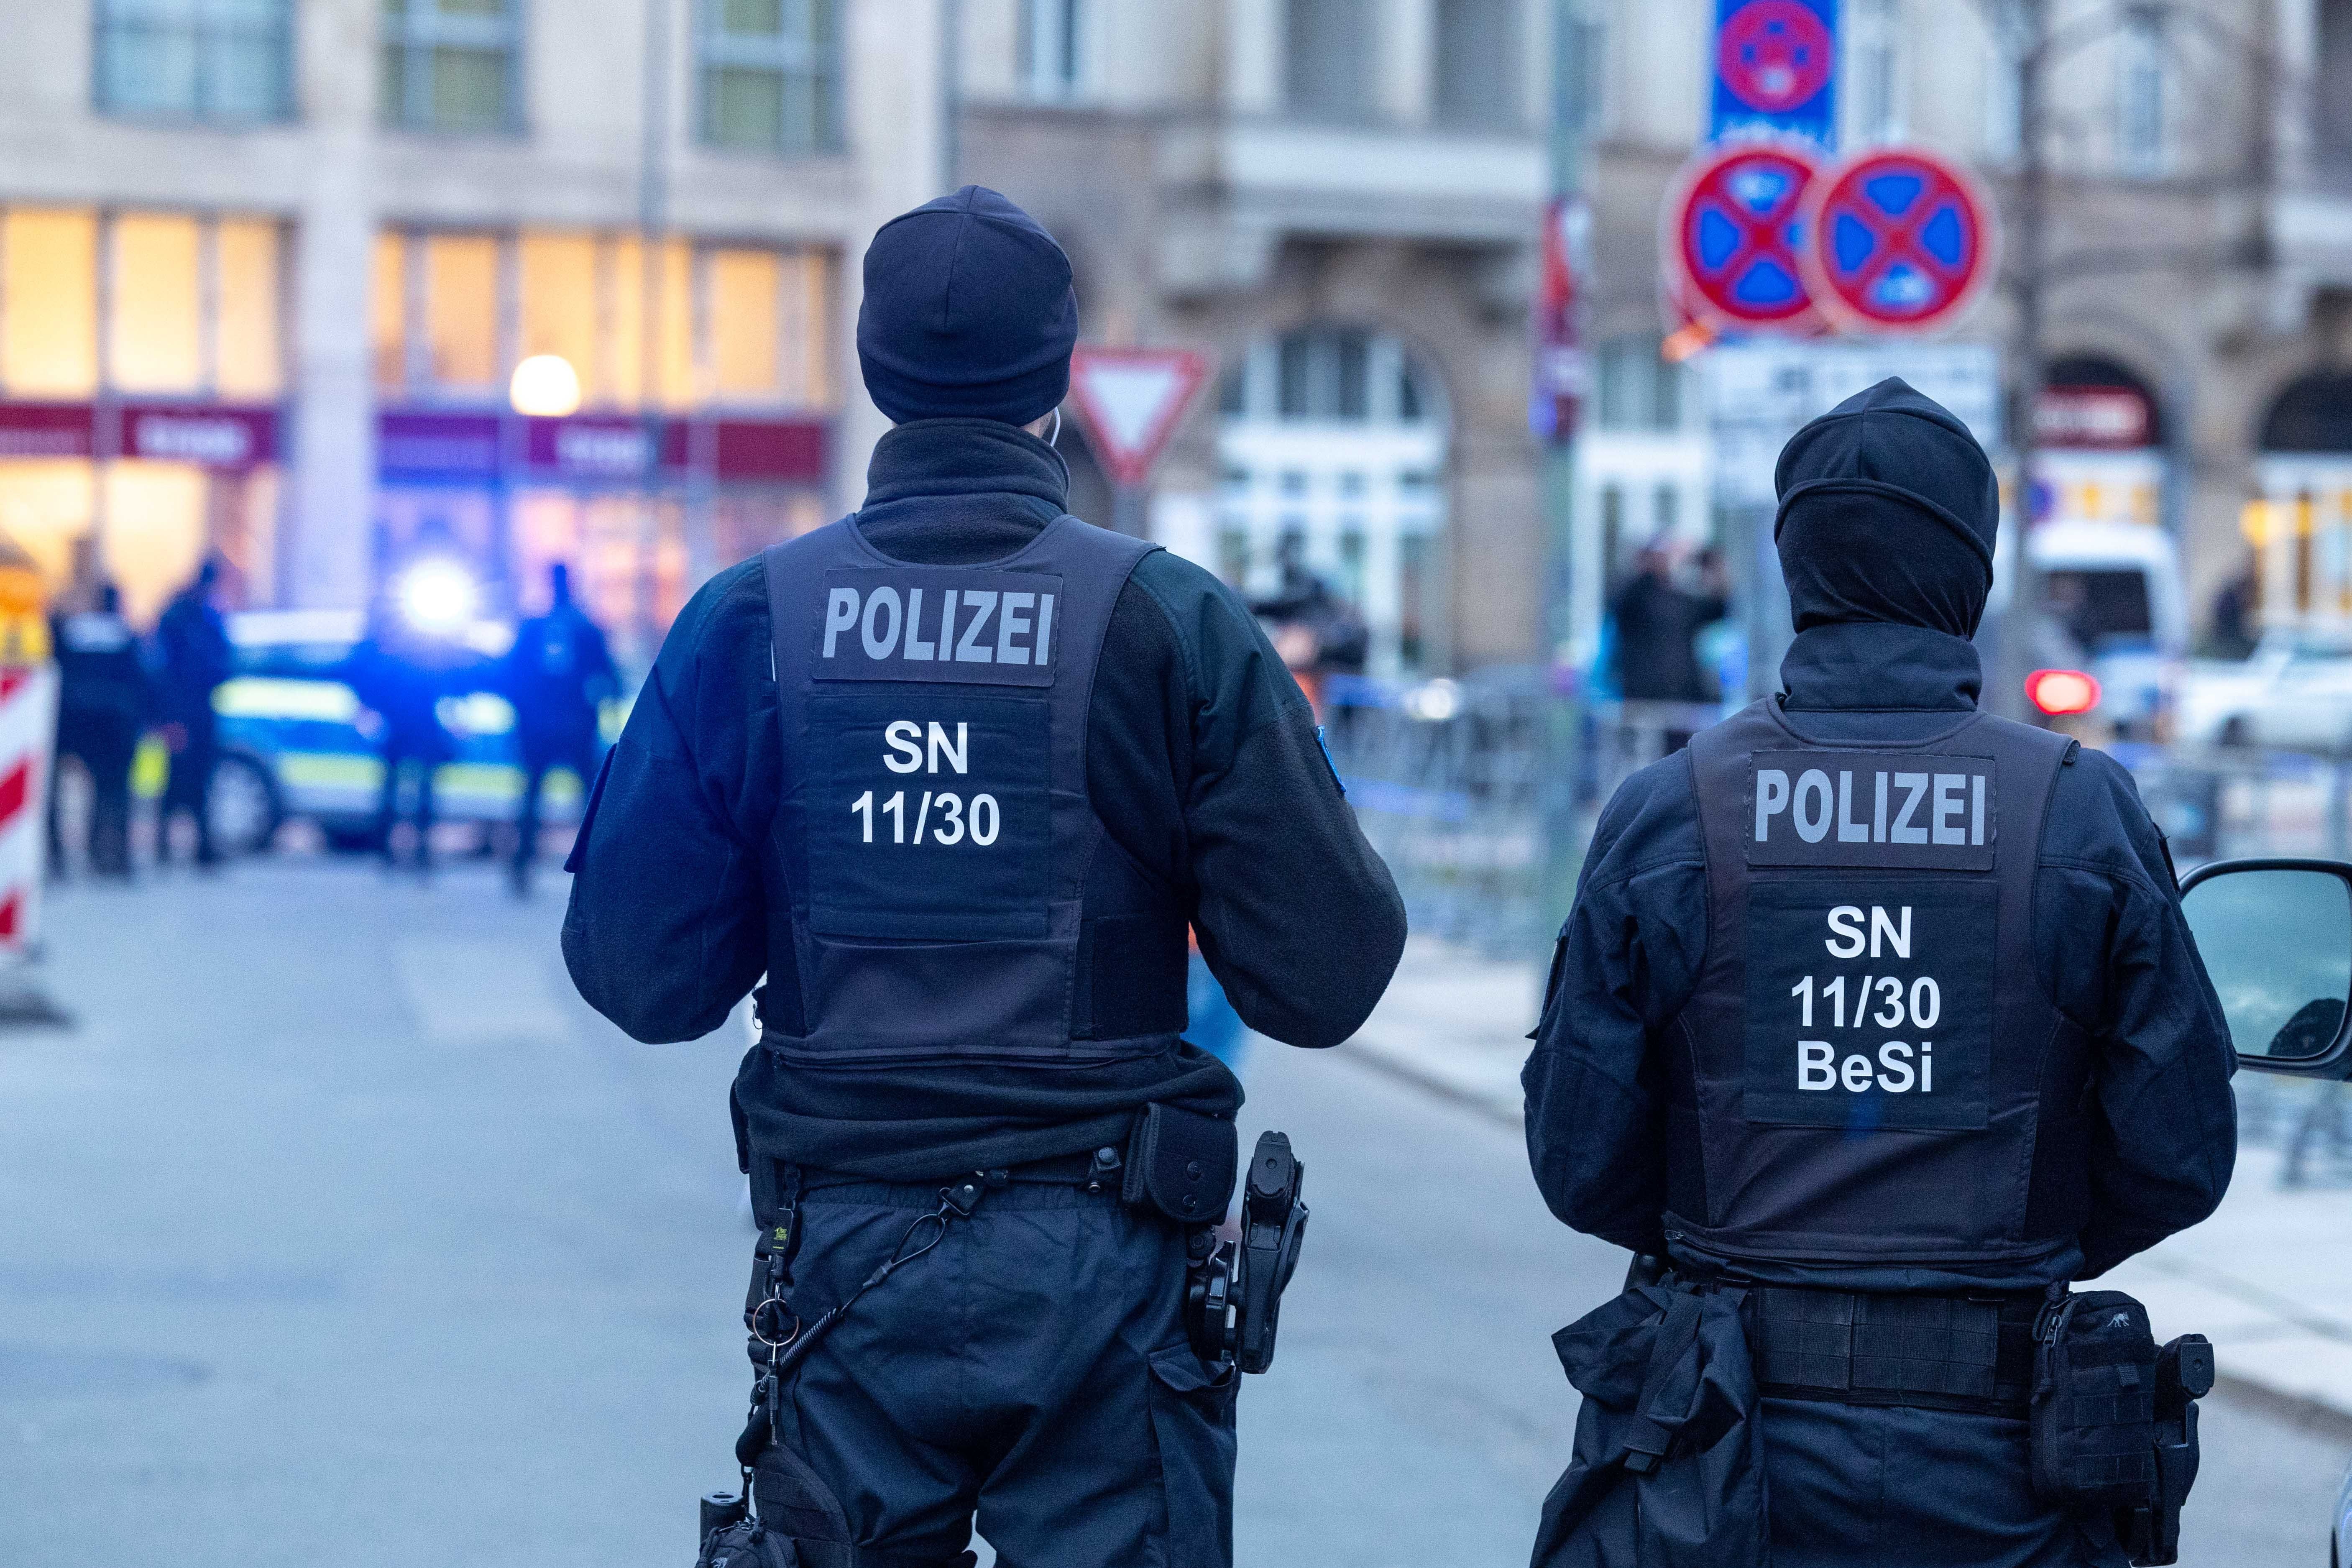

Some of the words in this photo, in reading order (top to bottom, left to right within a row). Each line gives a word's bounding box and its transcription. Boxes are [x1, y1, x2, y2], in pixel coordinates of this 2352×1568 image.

[822, 586, 1055, 665] POLIZEI
[883, 720, 967, 774] SN
[852, 791, 1000, 846] 11/30
[1755, 768, 1986, 846] POLIZEI
[1825, 906, 1912, 958] SN
[1792, 976, 1940, 1028] 11/30
[1798, 1041, 1931, 1092] BeSi
